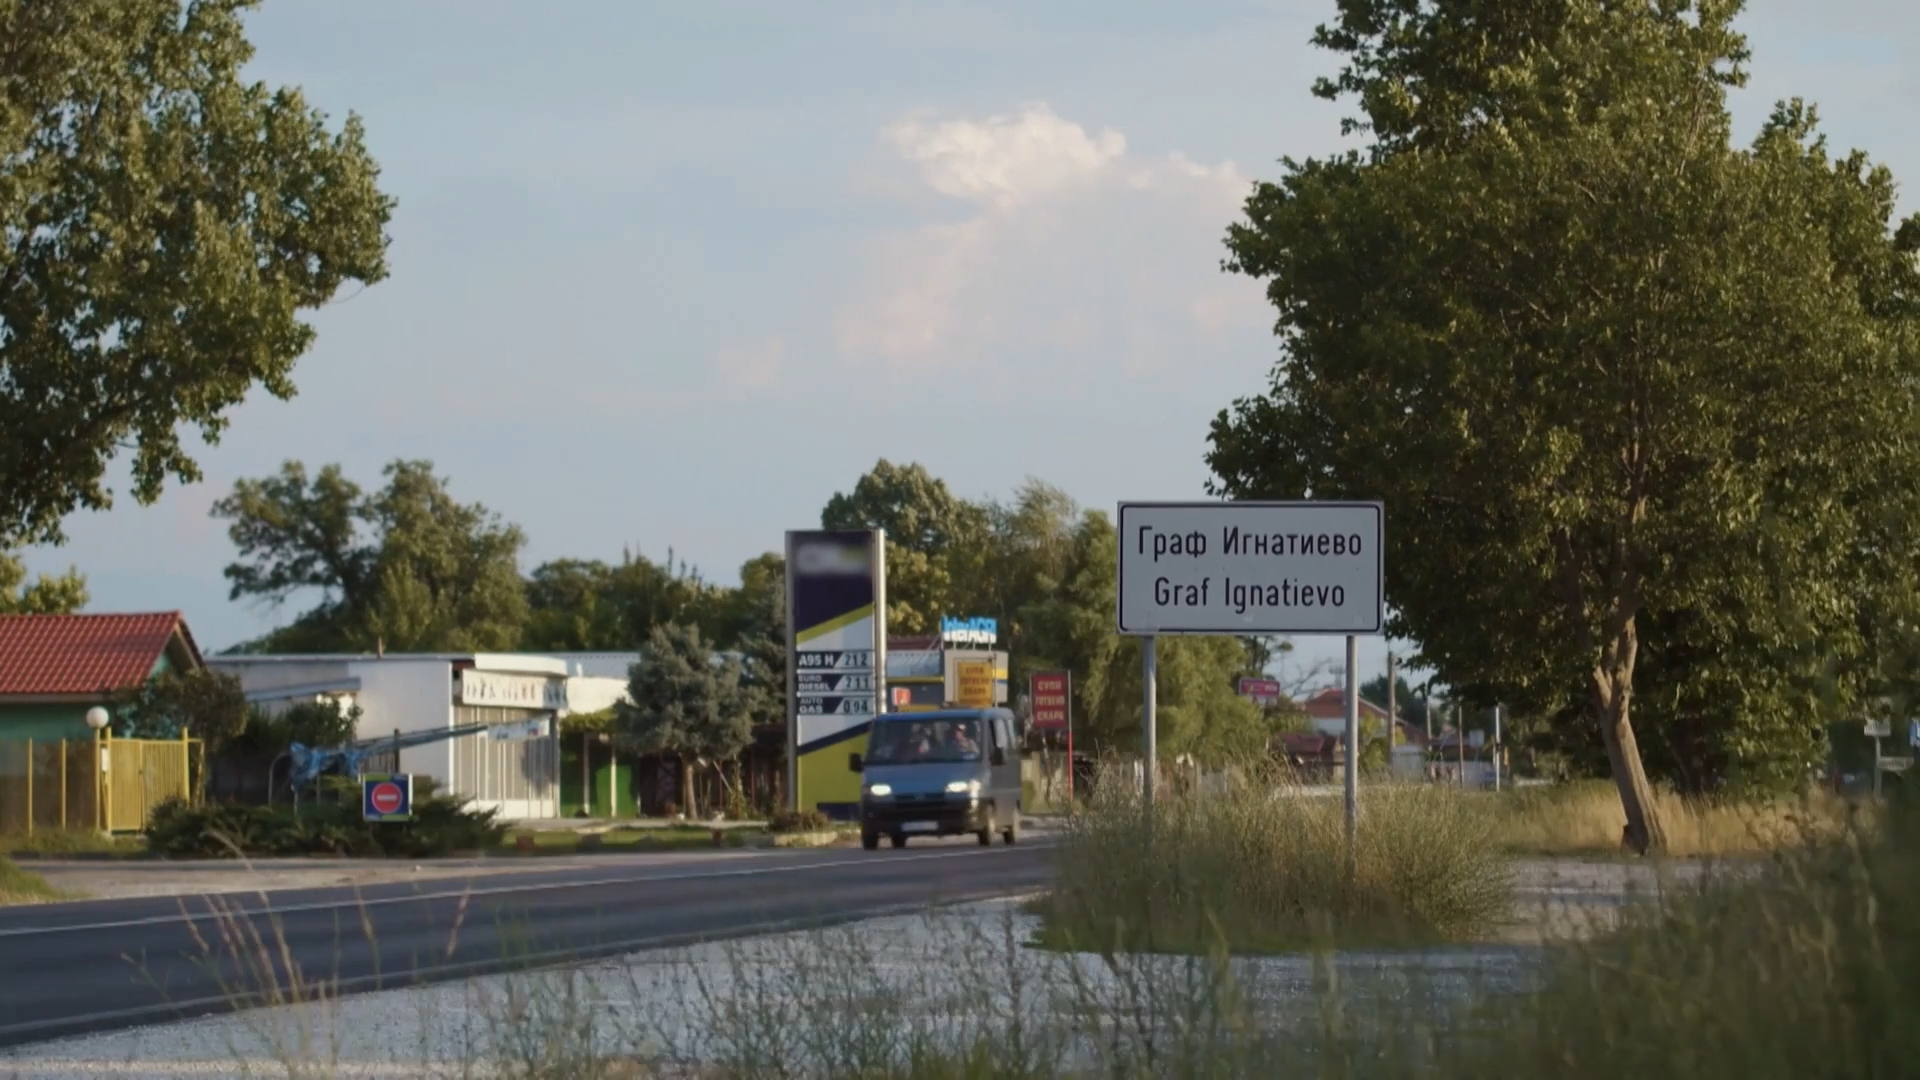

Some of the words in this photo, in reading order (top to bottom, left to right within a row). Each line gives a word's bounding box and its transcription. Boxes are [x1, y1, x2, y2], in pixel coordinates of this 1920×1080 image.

[1138, 525, 1207, 562] Граф
[1223, 525, 1362, 555] Игнатиево
[1154, 576, 1210, 606] Graf
[1225, 577, 1345, 614] Ignatievo
[799, 653, 822, 667] A95
[798, 683, 830, 691] DIESEL
[799, 697, 823, 705] AUTO
[799, 705, 823, 714] GAS
